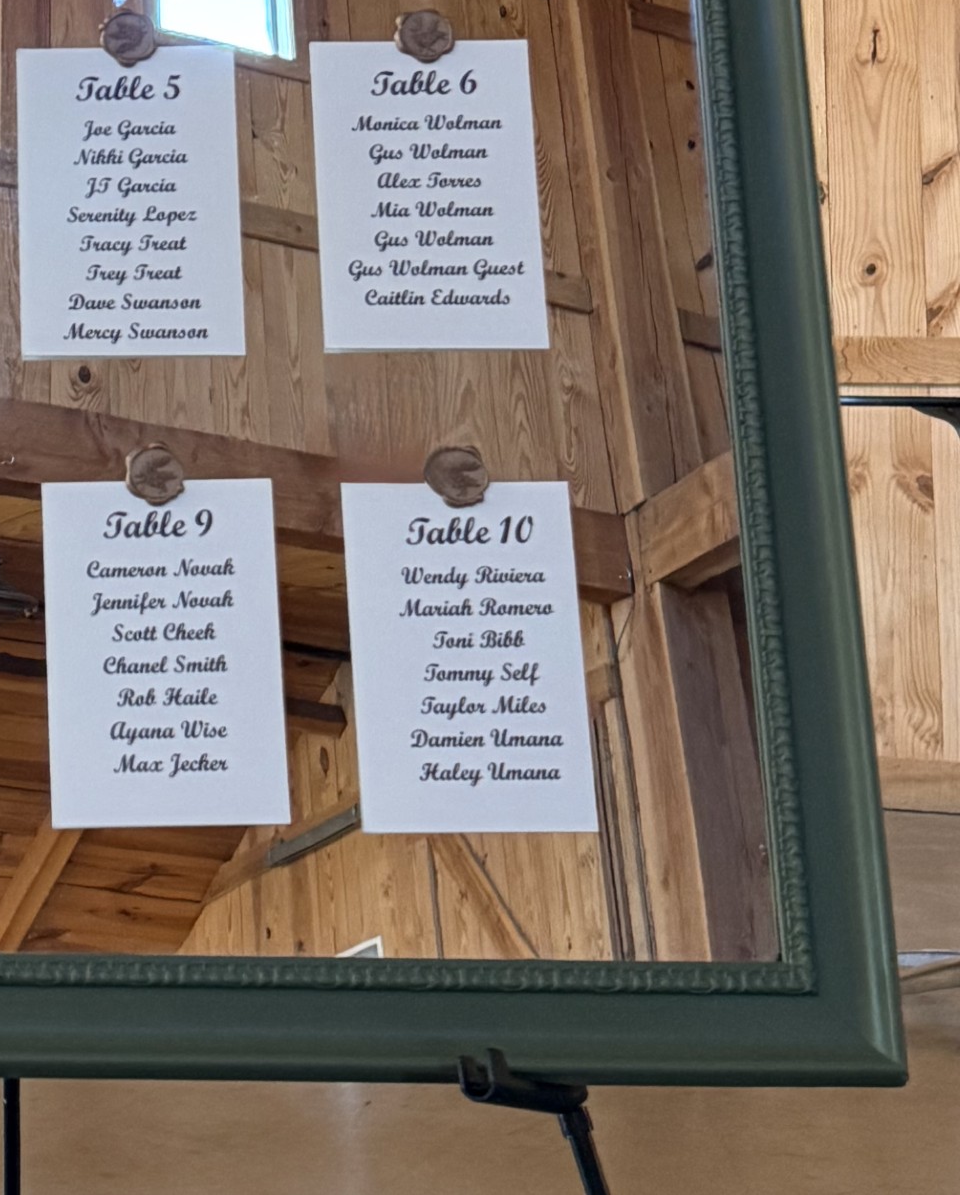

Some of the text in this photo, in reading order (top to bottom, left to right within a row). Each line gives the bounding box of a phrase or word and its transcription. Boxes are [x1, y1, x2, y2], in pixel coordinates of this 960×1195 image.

[76, 74, 180, 102] Table 5
[371, 69, 477, 96] Table 6
[83, 120, 176, 141] Joe Garcia
[351, 114, 502, 131] Monica Wolman
[73, 148, 188, 169] Nikki Garcia
[369, 143, 488, 165] Gus Wolman
[377, 172, 481, 189] Alex Torres
[79, 234, 187, 256] Tracy Treat
[374, 230, 494, 252] Gus Wolman
[86, 264, 182, 286] Trey Treat
[68, 293, 201, 310] Dave Swanson
[365, 288, 510, 306] Caitlin Edwards
[63, 323, 208, 344] Mercy Swanson
[103, 509, 213, 539] Table 9
[406, 516, 534, 545] Table 10
[86, 558, 235, 579] Cameron Novak
[91, 590, 234, 616] Jennifer Novak
[399, 598, 554, 617] Mariah Romero
[103, 654, 228, 675] Chanel Smith
[424, 663, 539, 687] Tommy Self
[117, 688, 156, 707] Rob
[421, 695, 547, 720] Taylor Miles
[411, 728, 564, 748] Damien Umana
[419, 762, 561, 787] Haley Umana
